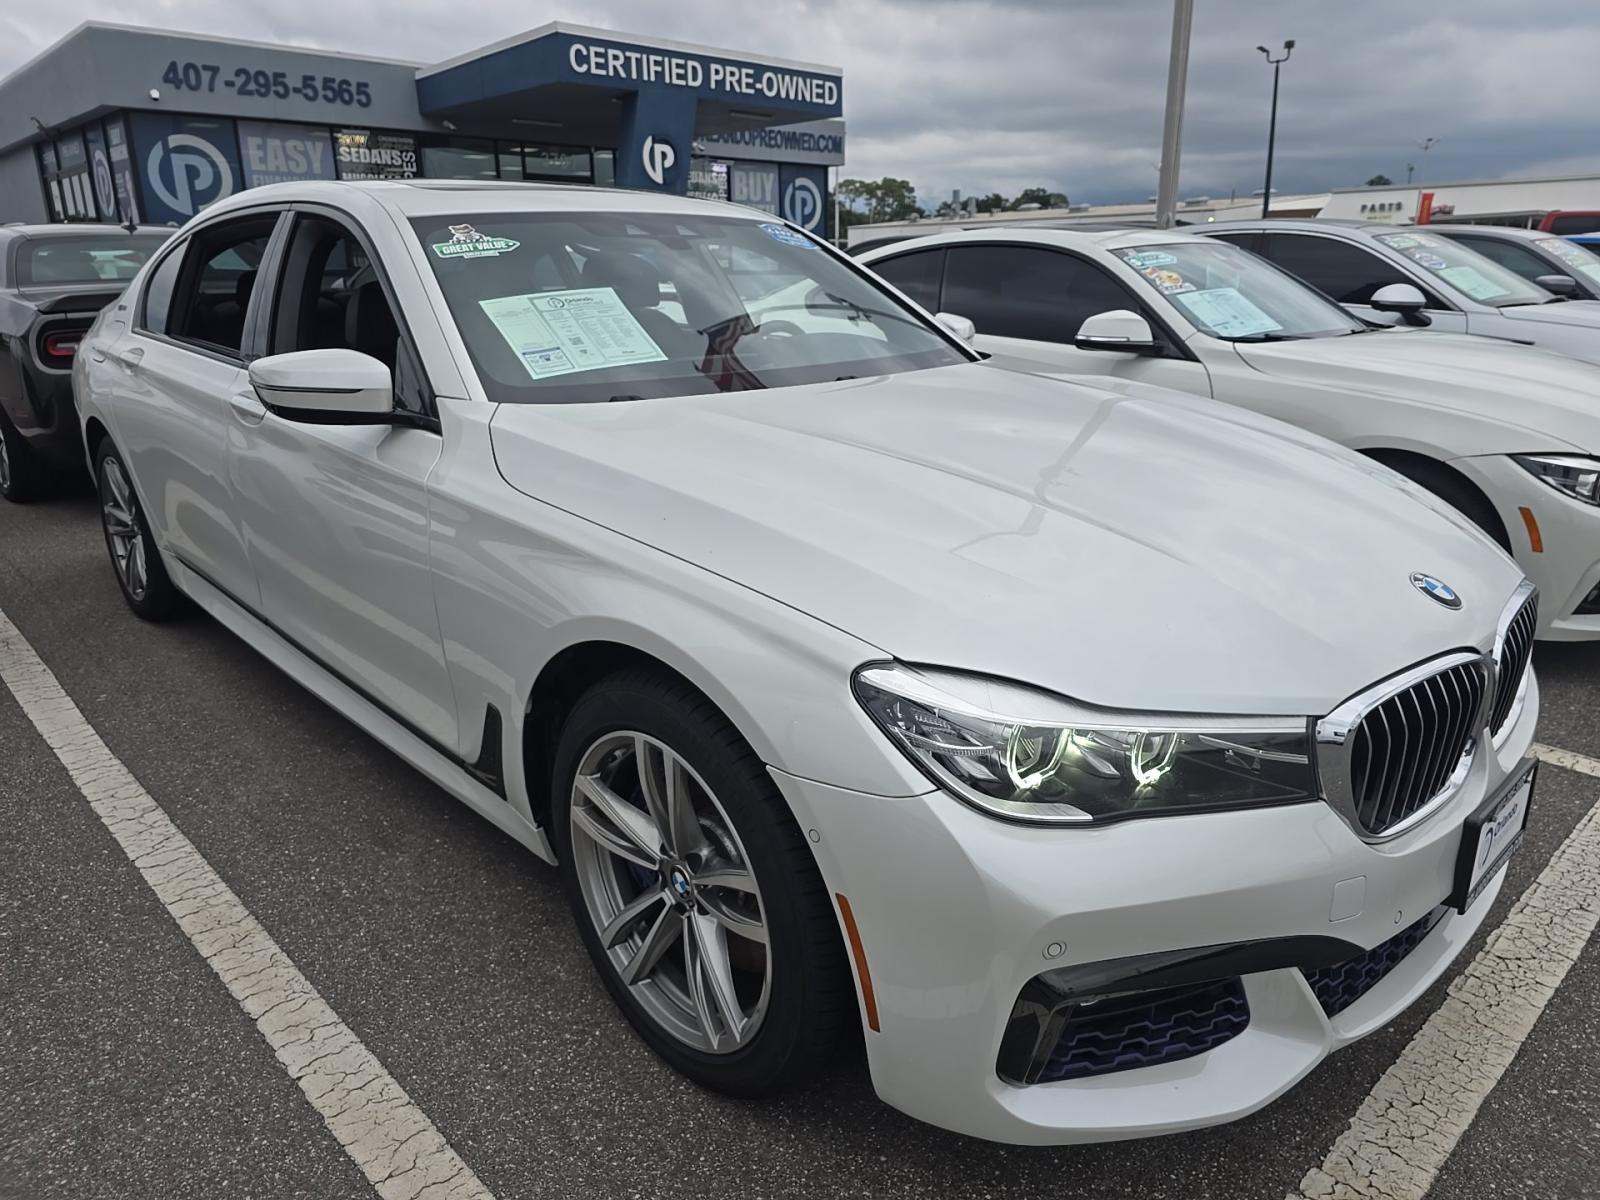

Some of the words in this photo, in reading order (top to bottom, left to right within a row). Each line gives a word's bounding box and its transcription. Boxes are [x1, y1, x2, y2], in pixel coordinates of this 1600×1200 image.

[162, 60, 372, 108] 407-295-5565
[569, 43, 703, 87] CERTIFIED
[709, 63, 838, 105] PRE-OWNED
[247, 136, 324, 174] EASY
[338, 146, 402, 166] SEDANS
[734, 170, 774, 202] BUY
[442, 242, 475, 254] GREAT
[477, 240, 508, 250] VALUE
